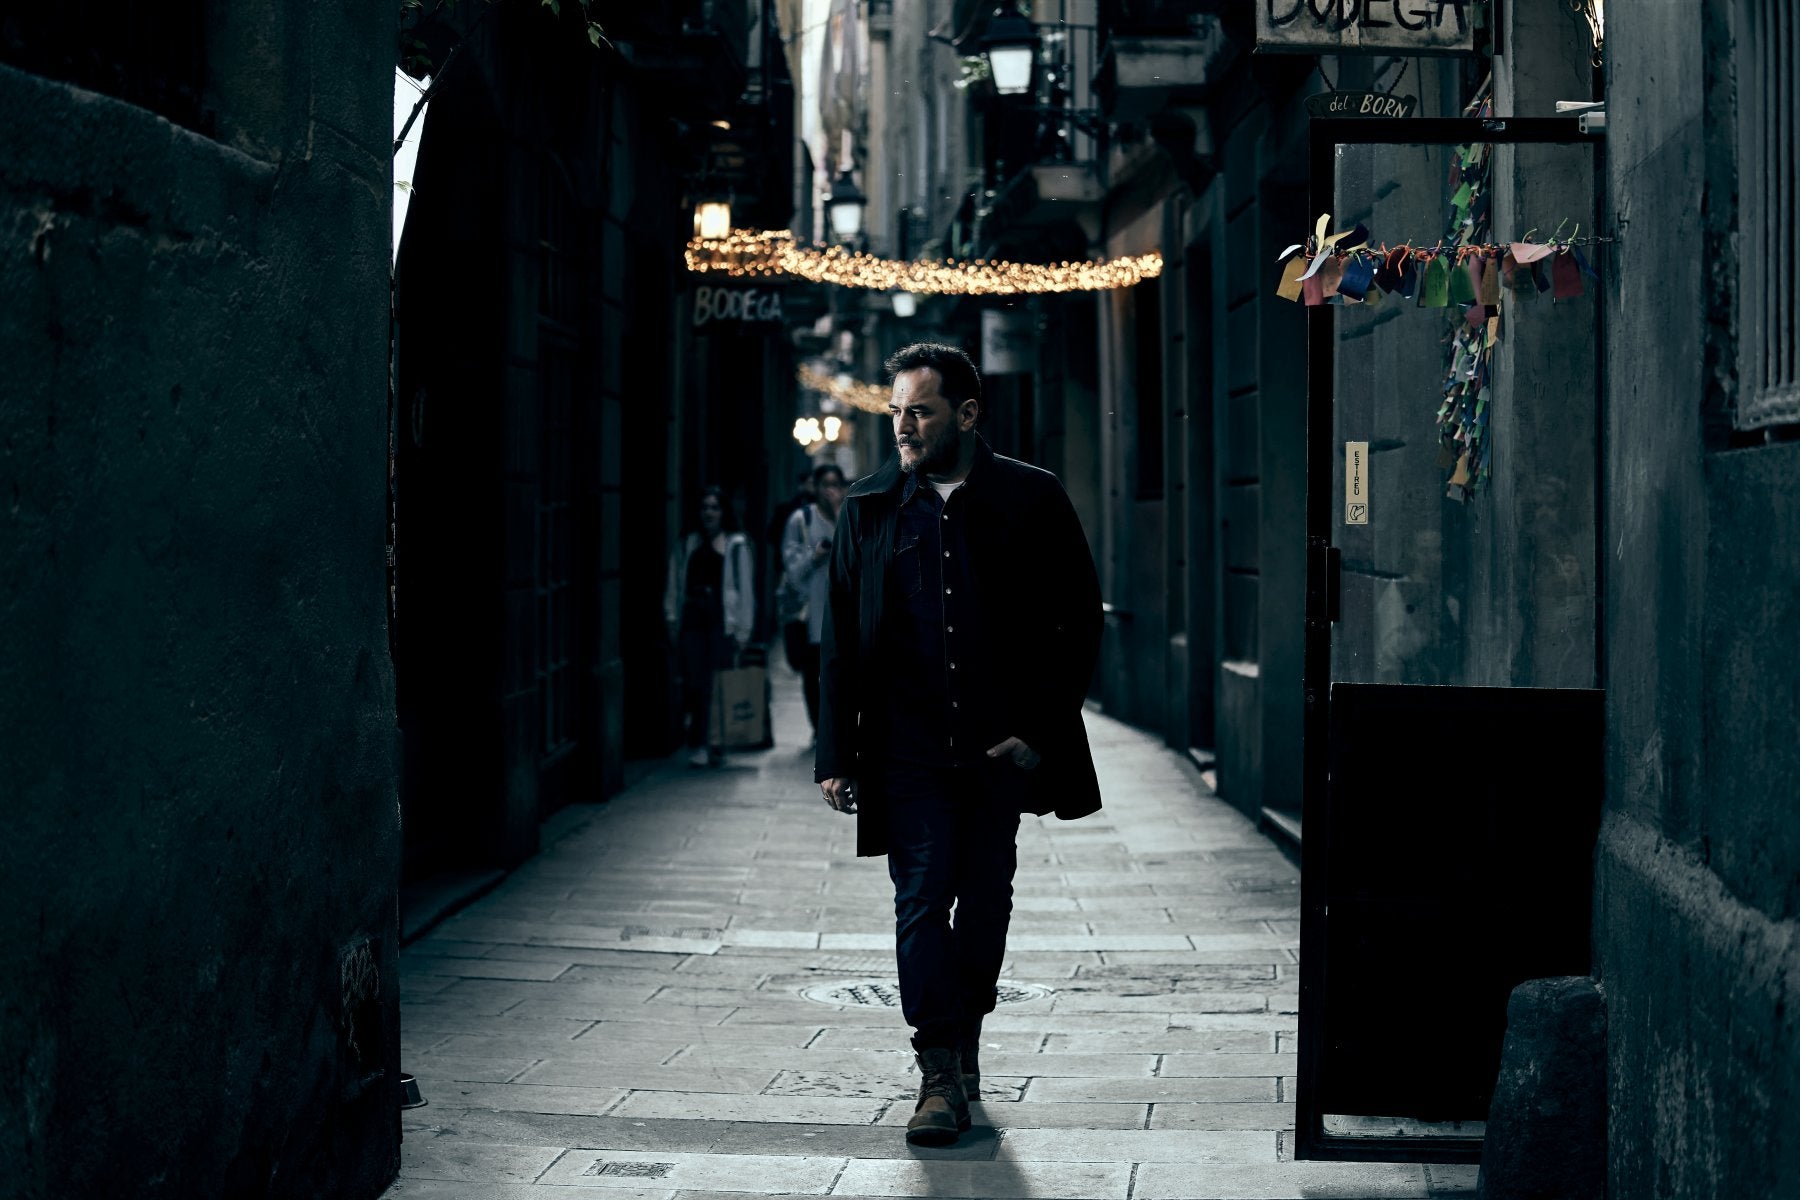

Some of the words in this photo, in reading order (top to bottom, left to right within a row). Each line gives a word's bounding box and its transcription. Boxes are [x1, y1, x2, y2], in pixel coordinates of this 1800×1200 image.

[1329, 94, 1349, 112] del
[1359, 94, 1408, 118] BORN
[693, 285, 782, 328] BODEGA
